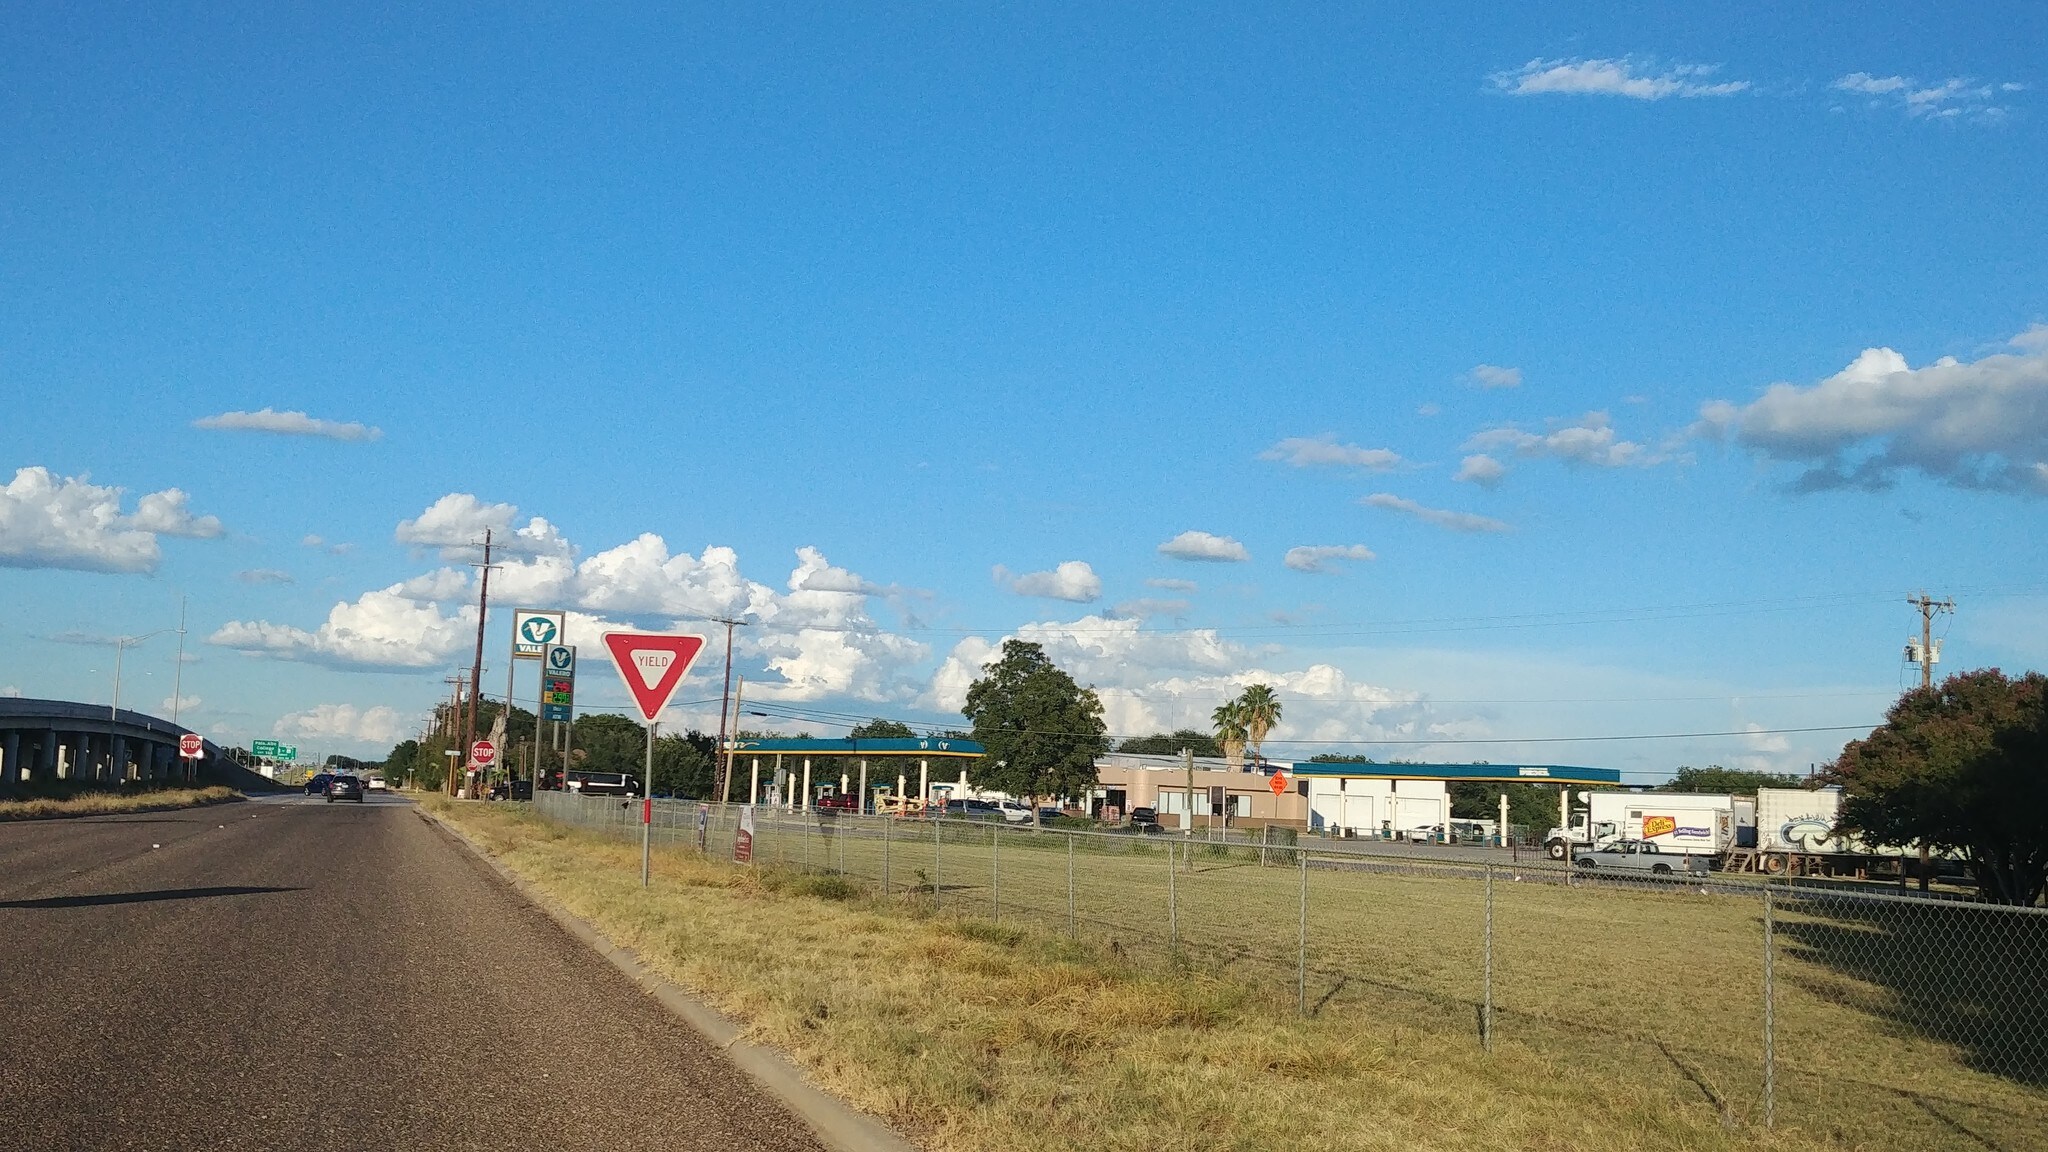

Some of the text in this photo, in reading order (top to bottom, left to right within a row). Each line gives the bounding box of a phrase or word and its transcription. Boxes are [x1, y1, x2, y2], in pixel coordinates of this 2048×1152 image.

[638, 656, 669, 667] YIELD
[181, 740, 201, 749] STOP
[473, 748, 494, 757] STOP
[1647, 823, 1671, 833] Express
[1651, 820, 1665, 828] Deli
